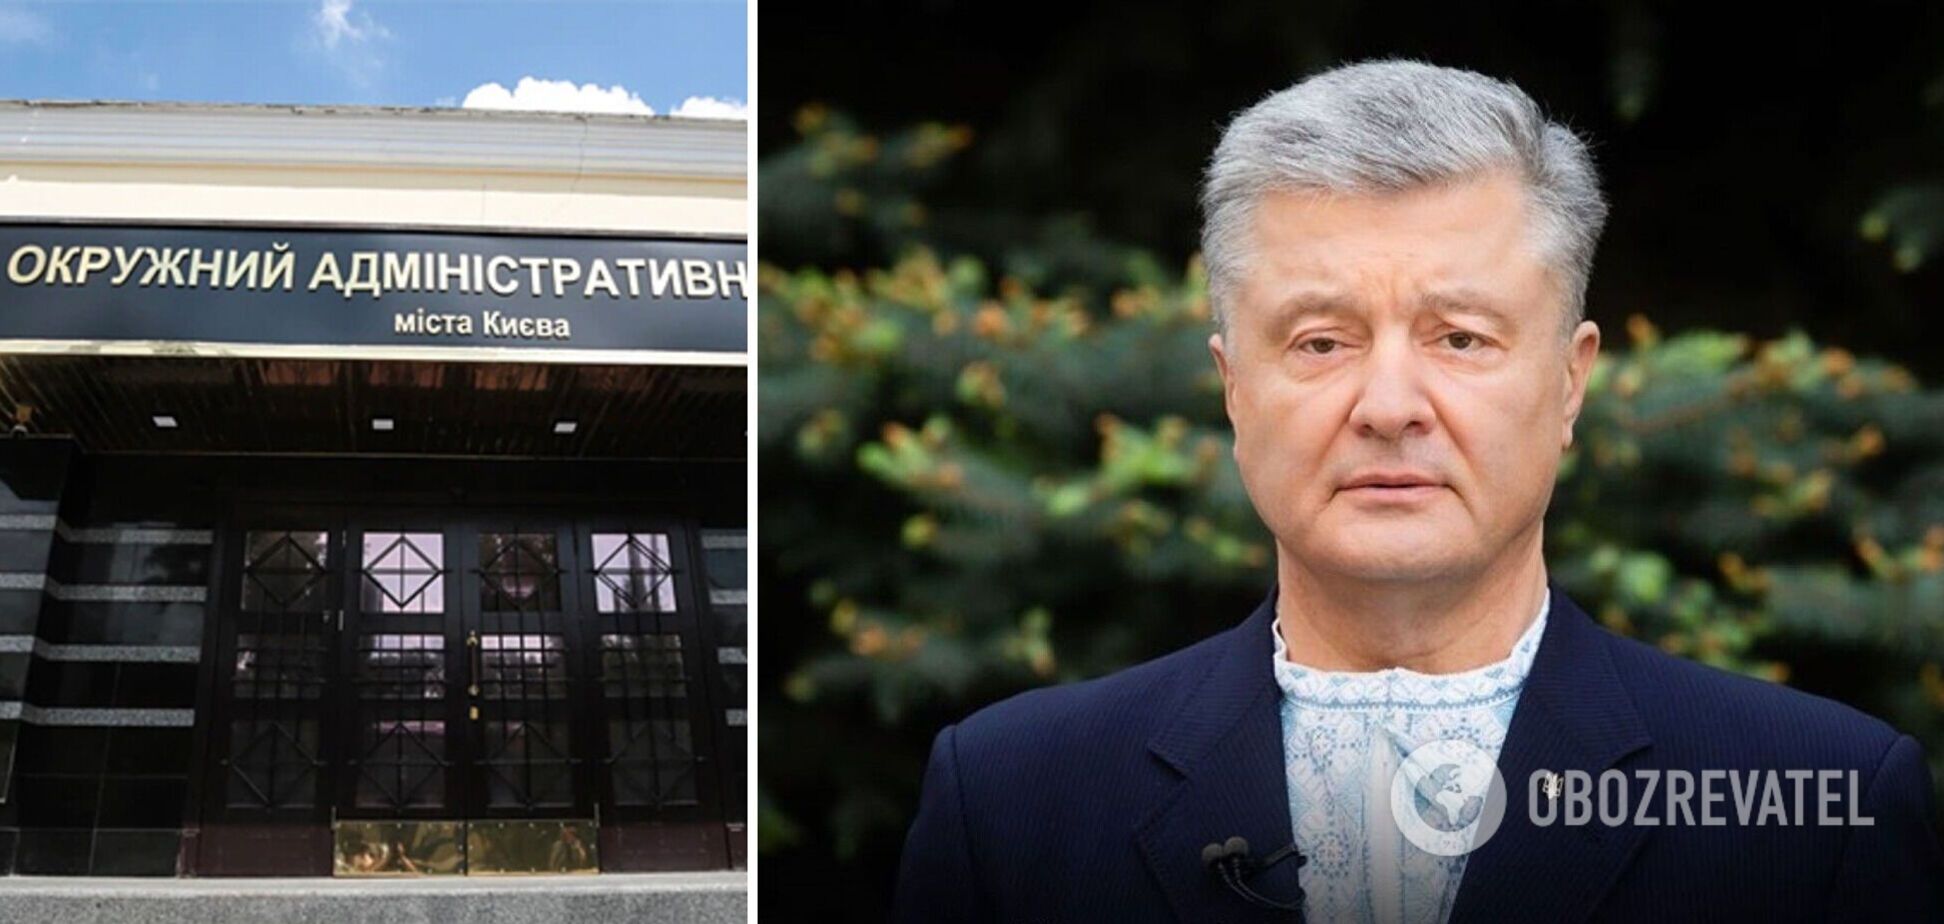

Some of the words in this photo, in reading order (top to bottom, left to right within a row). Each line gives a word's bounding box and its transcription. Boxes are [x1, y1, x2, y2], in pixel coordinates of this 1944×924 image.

[7, 241, 296, 289] ОКРУЖНИЙ
[308, 250, 747, 298] АДМІНІСТРАТИВН
[394, 308, 473, 334] міста
[483, 310, 571, 337] Києва
